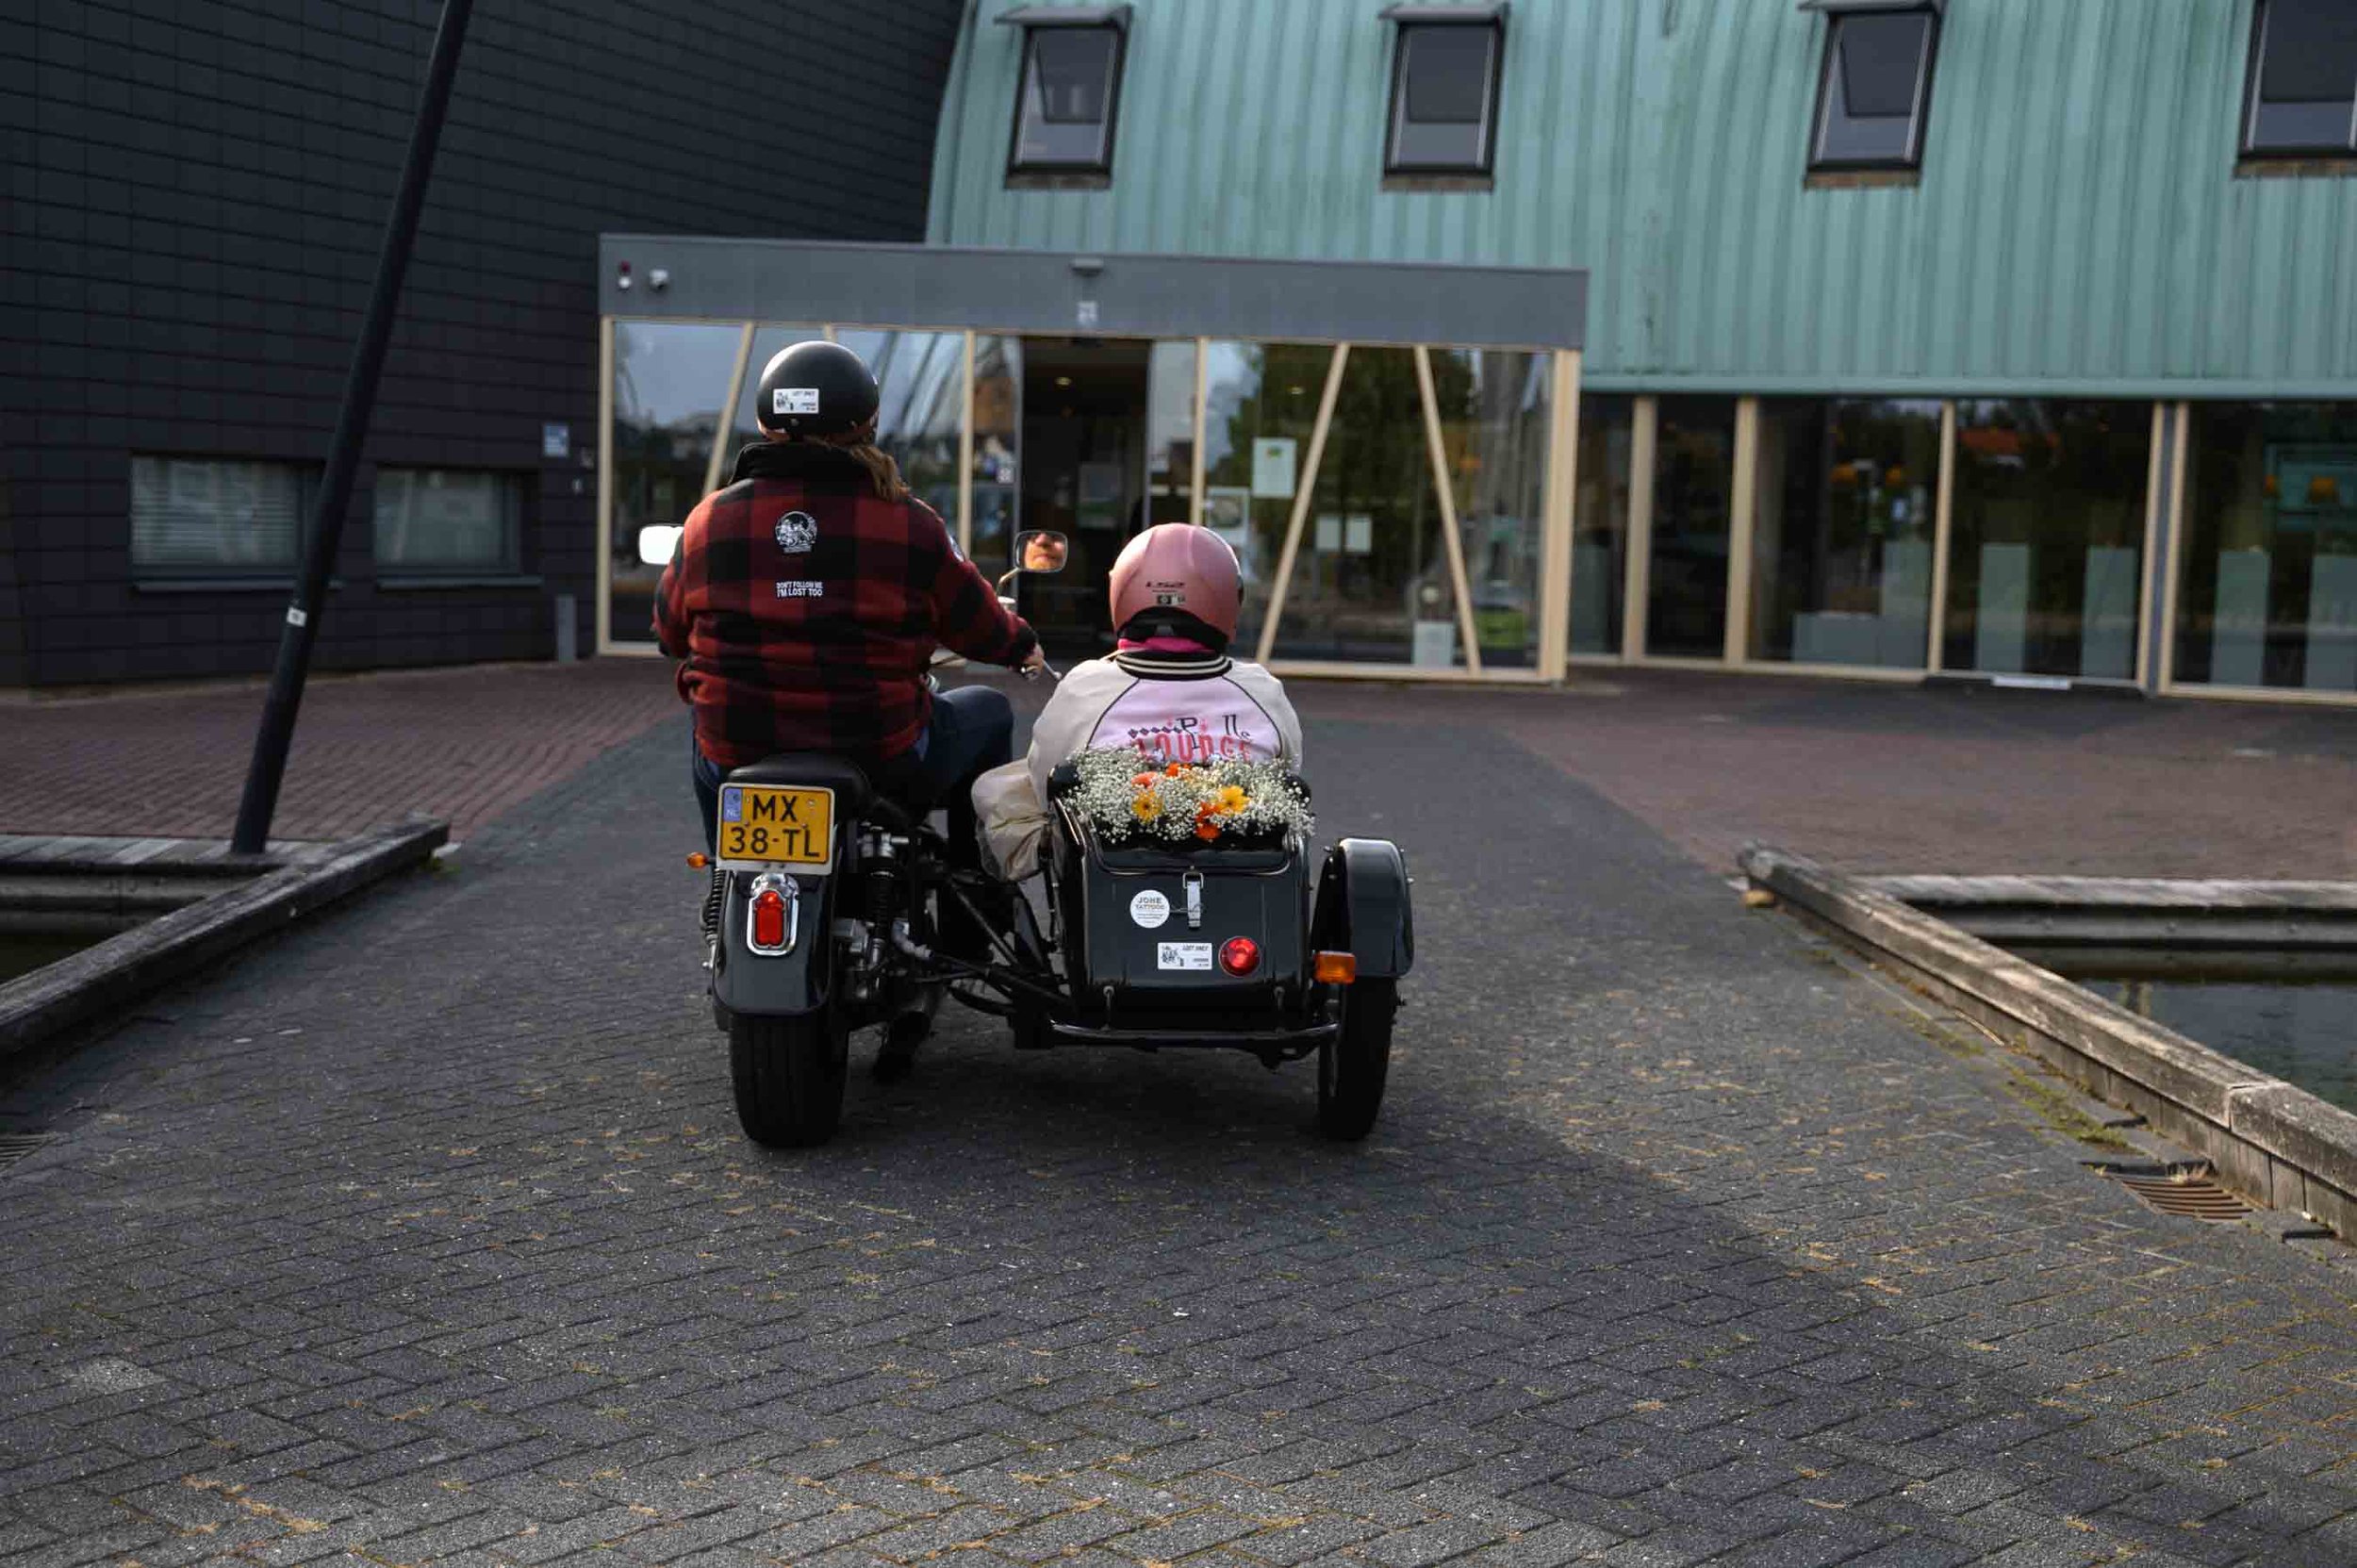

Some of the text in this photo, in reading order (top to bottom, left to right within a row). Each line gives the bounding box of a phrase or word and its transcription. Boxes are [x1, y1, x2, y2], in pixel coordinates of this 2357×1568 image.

[777, 588, 823, 598] I'M LOST TOO
[726, 809, 739, 817] NL
[752, 794, 798, 822] MX
[728, 826, 820, 858] 38-TL
